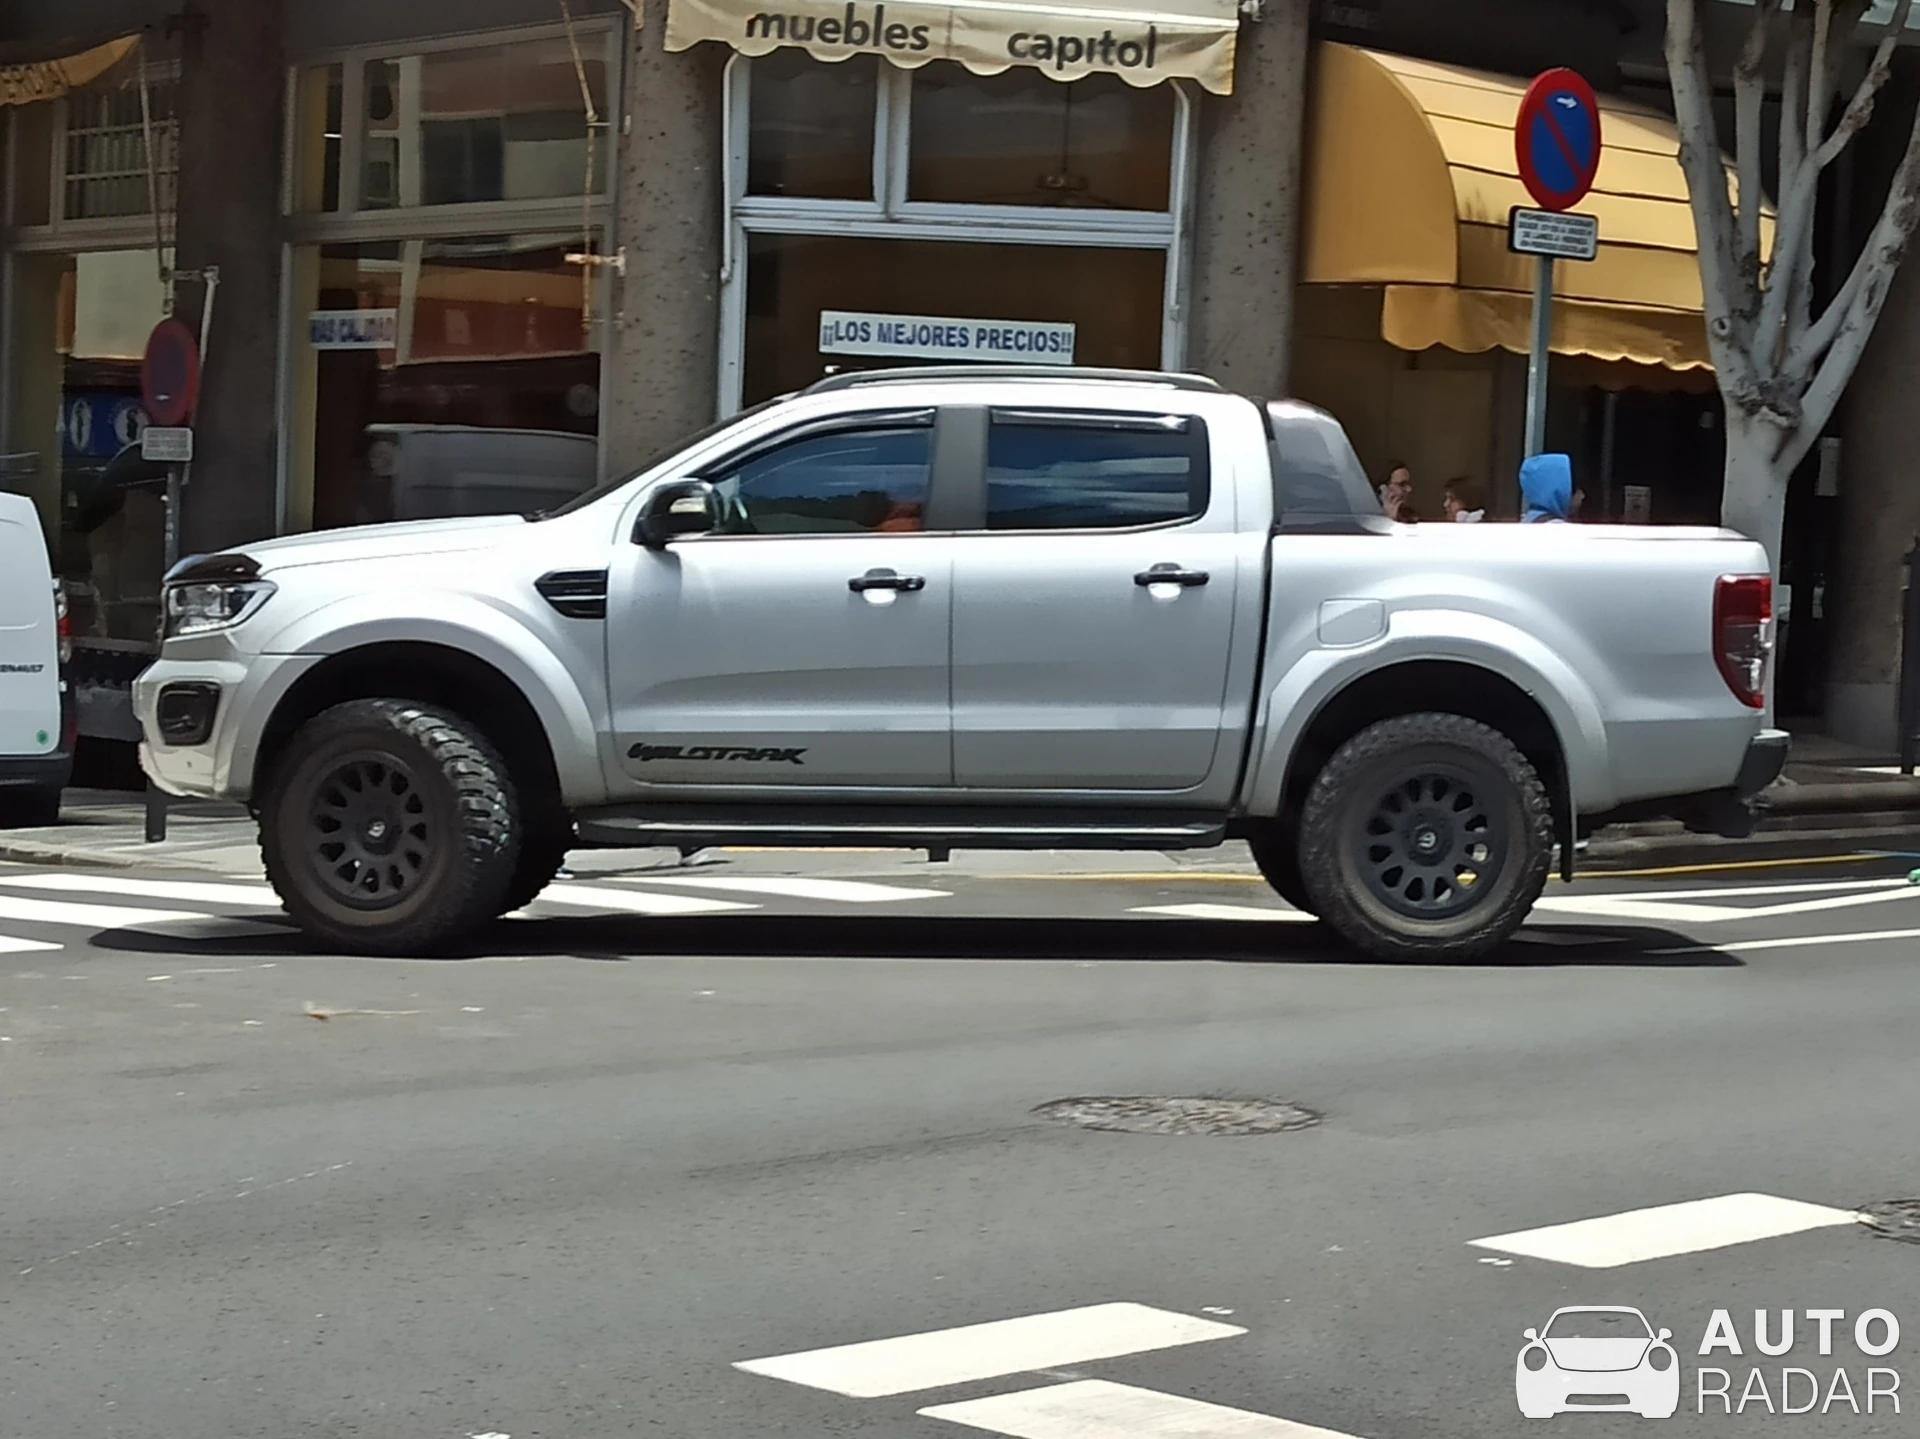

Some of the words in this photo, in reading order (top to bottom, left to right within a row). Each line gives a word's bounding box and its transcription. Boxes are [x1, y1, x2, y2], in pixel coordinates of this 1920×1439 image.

[745, 2, 930, 51] muebles
[1007, 26, 1157, 71] capitol
[877, 322, 970, 348] MEJORES
[975, 327, 1072, 354] PRECIOS!!
[626, 742, 810, 765] WILDTRAK
